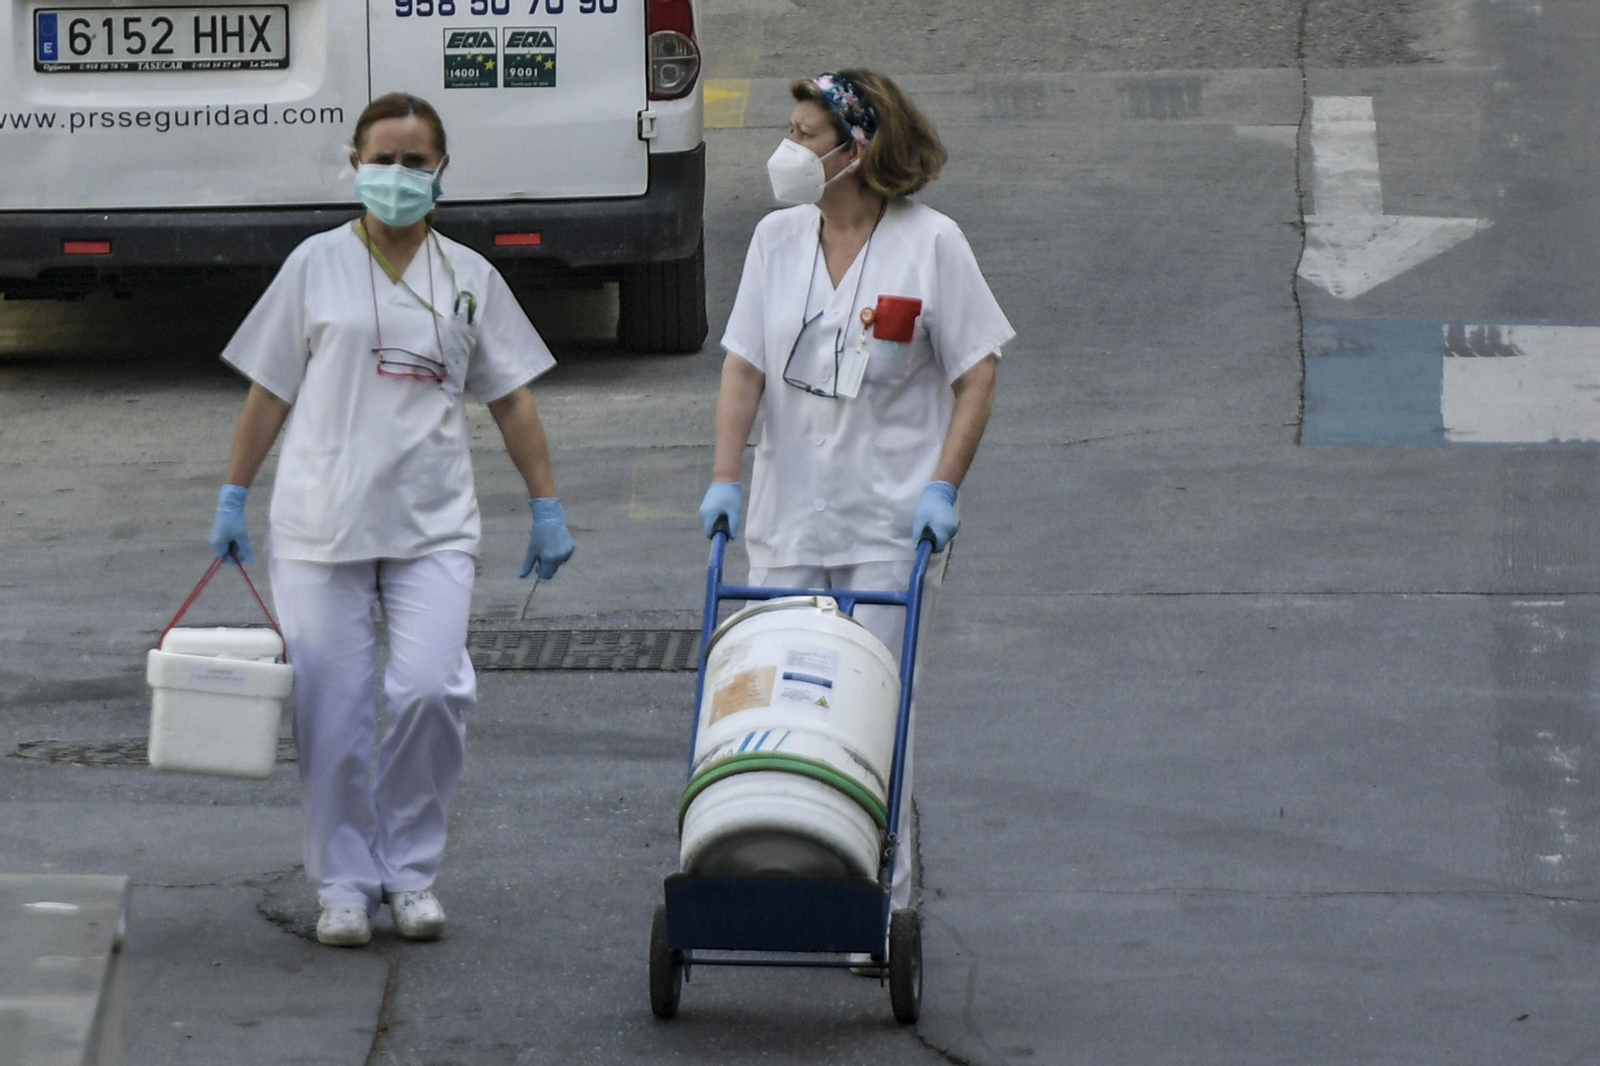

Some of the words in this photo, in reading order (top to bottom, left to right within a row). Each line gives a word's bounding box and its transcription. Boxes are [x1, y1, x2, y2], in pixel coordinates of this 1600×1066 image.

[394, 0, 456, 17] 958
[470, 0, 510, 16] 50
[579, 0, 618, 14] 90
[68, 17, 174, 56] 6152
[193, 14, 272, 54] HHX
[43, 42, 53, 54] E
[137, 61, 183, 70] TASECAR
[450, 68, 480, 78] 14001
[509, 67, 538, 77] 9001
